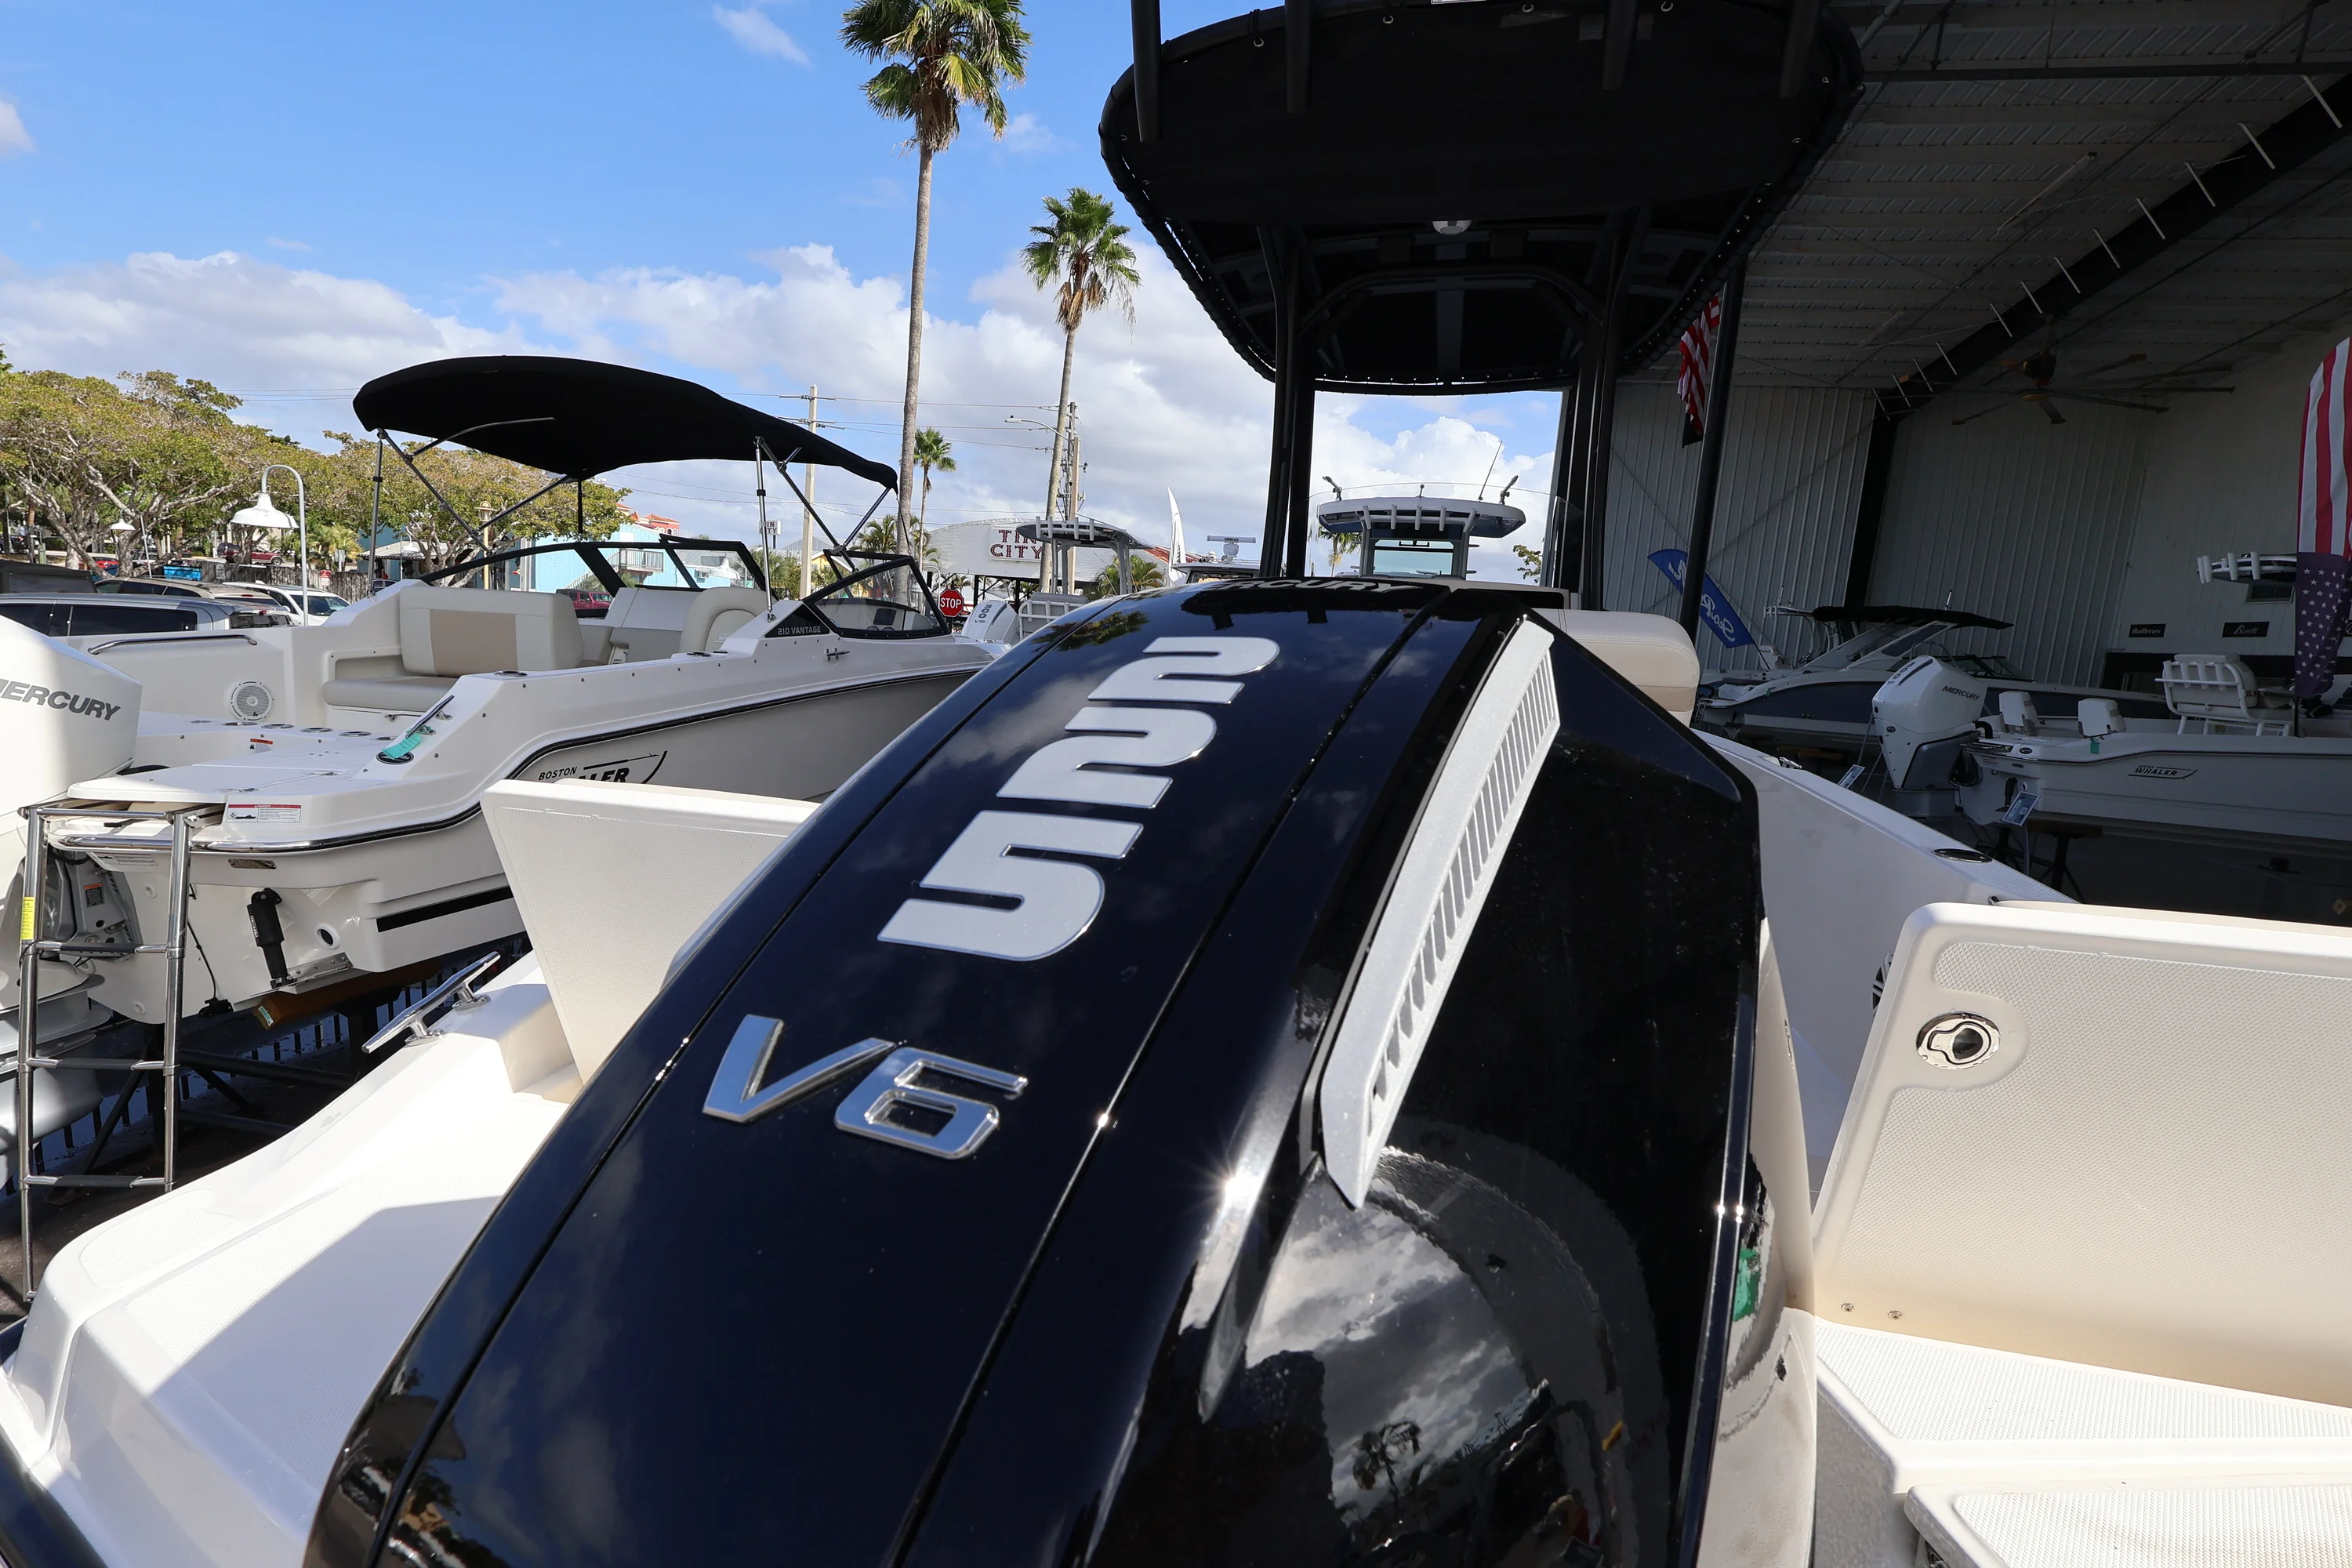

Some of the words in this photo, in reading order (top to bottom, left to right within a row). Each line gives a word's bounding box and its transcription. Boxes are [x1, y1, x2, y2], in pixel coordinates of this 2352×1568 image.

[989, 543, 1043, 559] CITY
[940, 597, 962, 609] STOP
[791, 626, 822, 634] VANTAGE
[1942, 686, 1980, 700] MERCURY
[539, 766, 578, 781] BOSTON
[2135, 768, 2178, 776] WHALER
[877, 636, 1280, 963] 225
[702, 1014, 1029, 1160] V6
